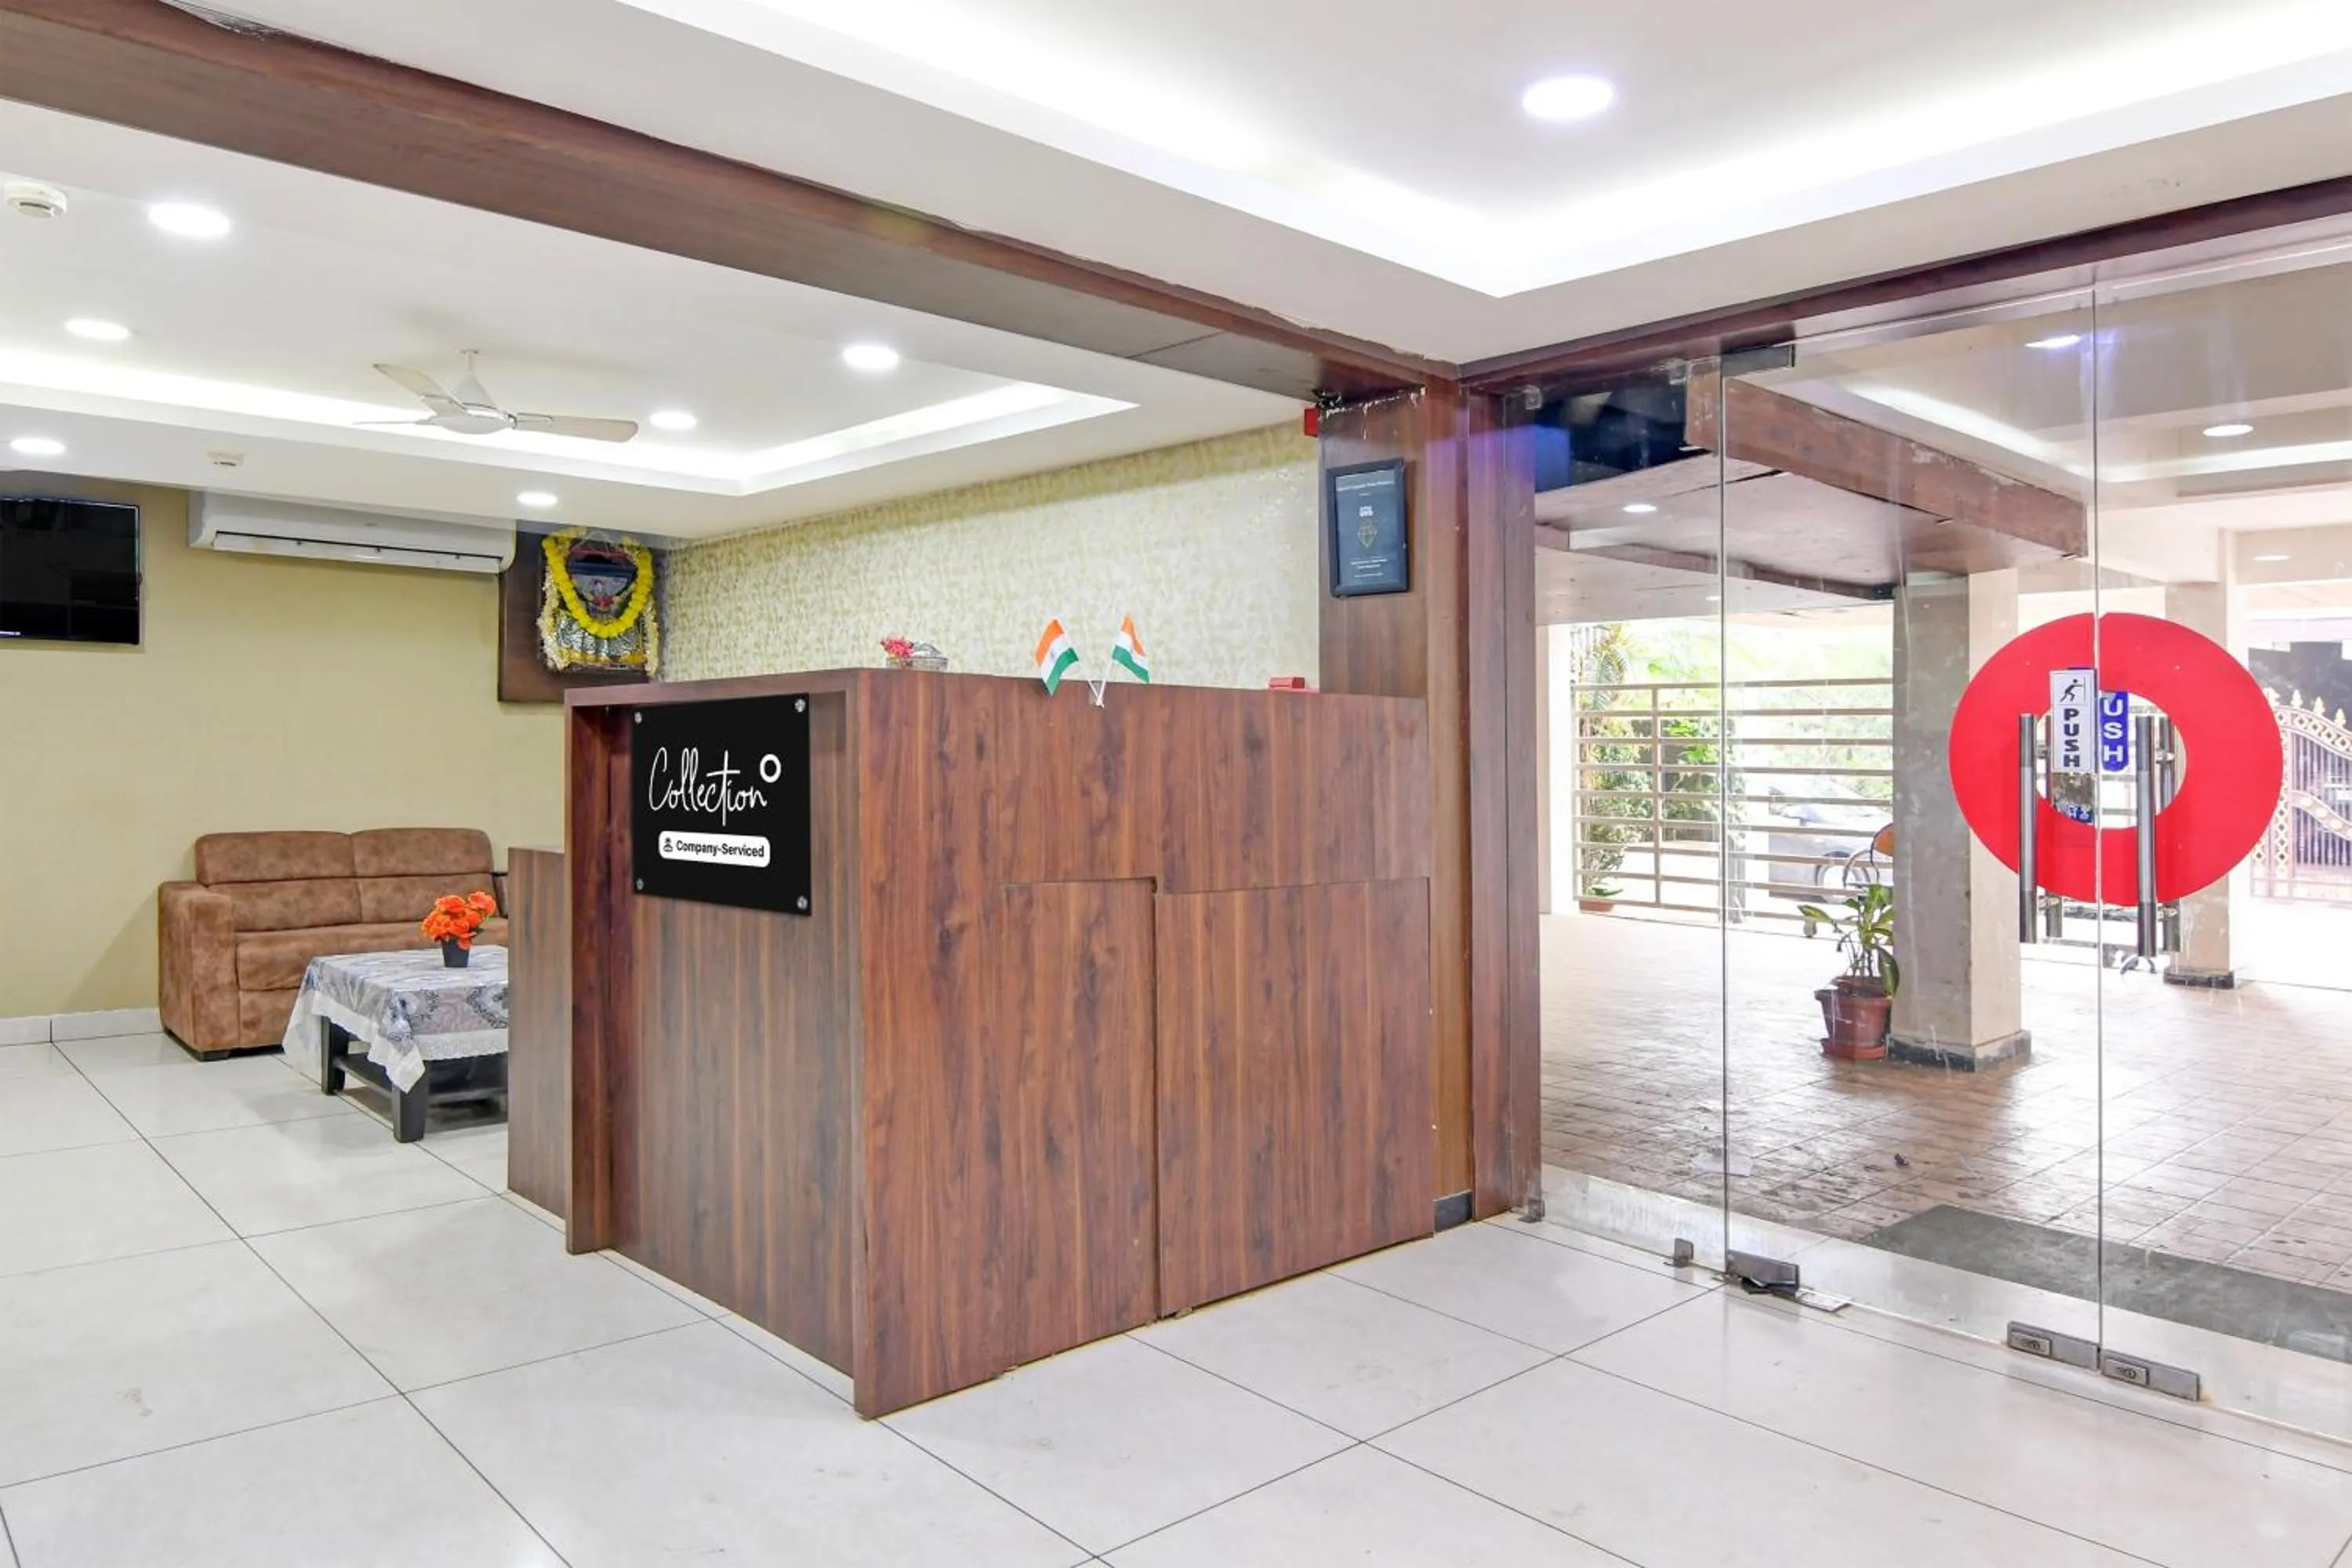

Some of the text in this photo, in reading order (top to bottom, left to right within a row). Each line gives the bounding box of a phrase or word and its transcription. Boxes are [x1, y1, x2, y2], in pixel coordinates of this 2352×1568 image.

[2063, 708, 2080, 768] PUSH
[2103, 699, 2124, 763] USH
[648, 746, 768, 826] Collection
[676, 840, 764, 858] Company-Serviced
